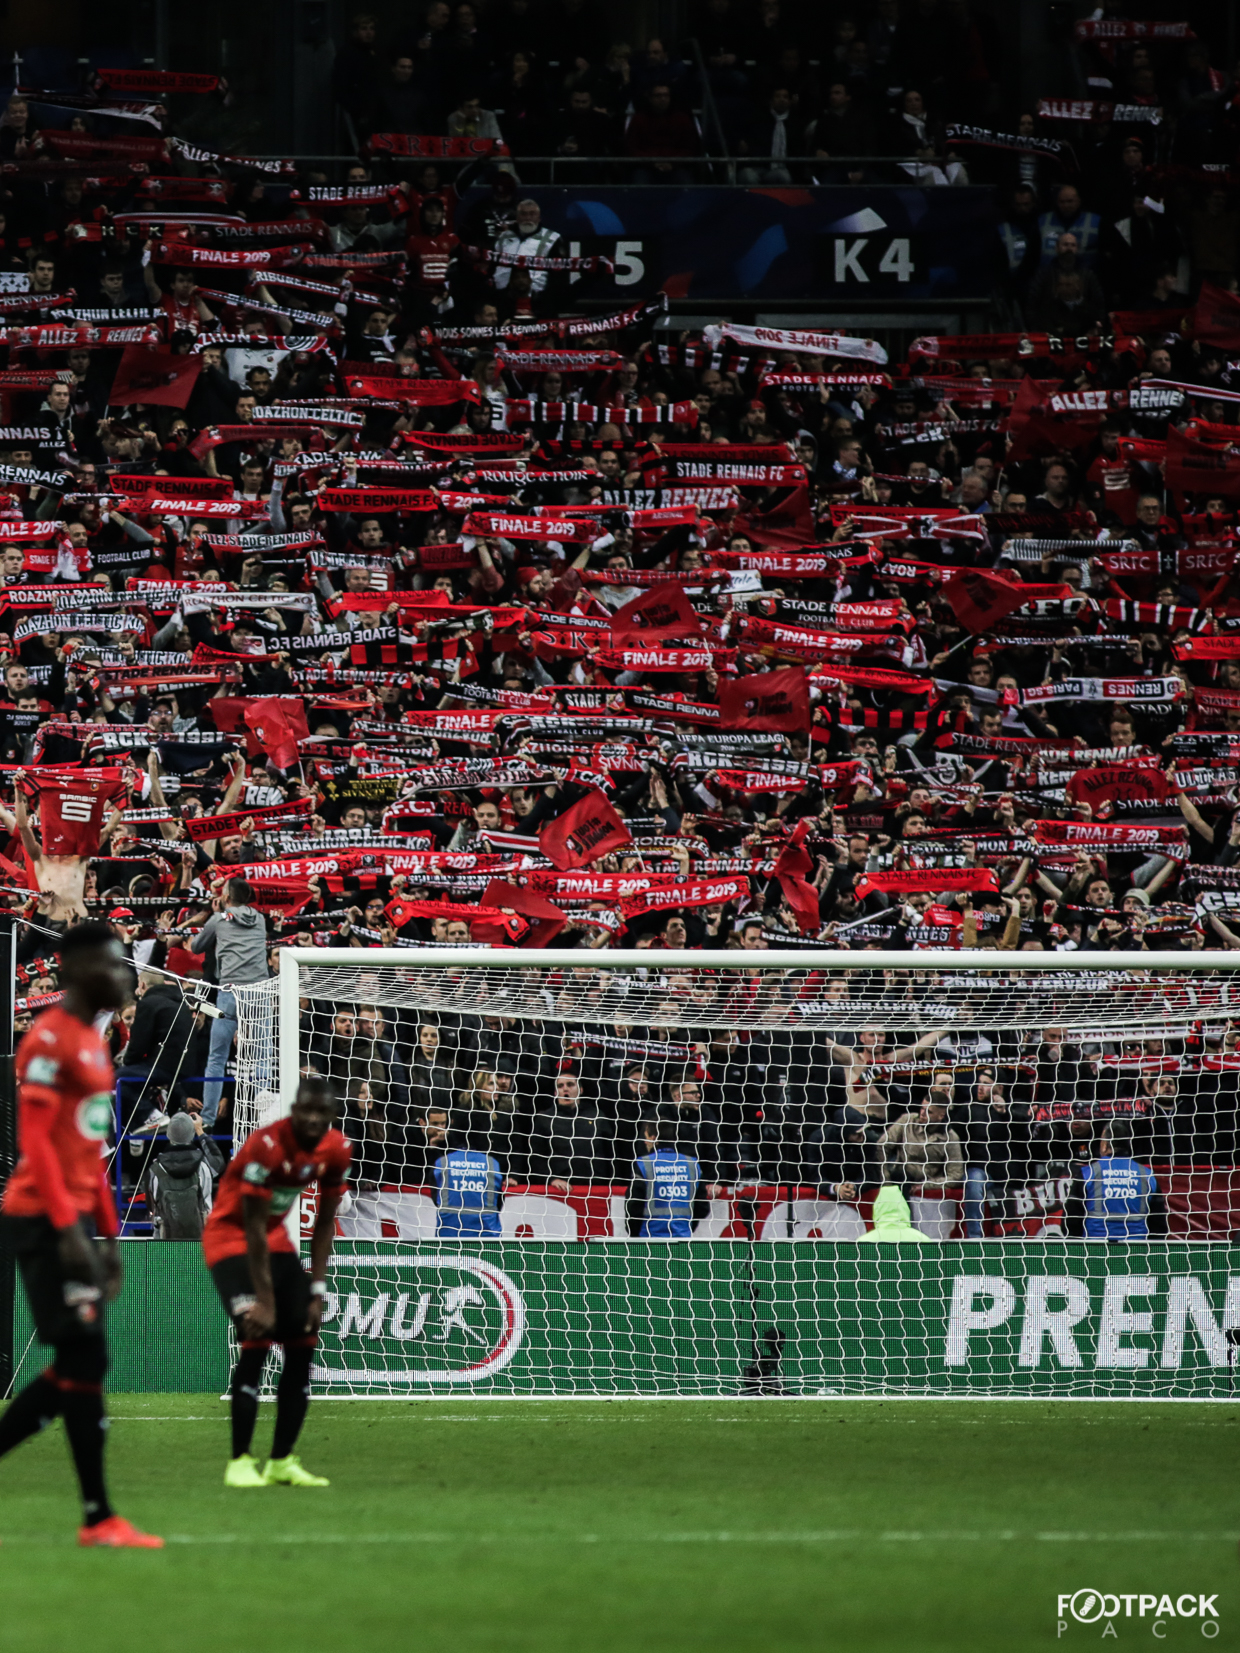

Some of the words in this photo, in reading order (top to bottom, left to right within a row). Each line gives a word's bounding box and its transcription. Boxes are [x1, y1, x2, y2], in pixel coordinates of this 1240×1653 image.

[192, 249, 240, 263] FINALE
[243, 251, 271, 264] 2019
[834, 239, 915, 282] K4
[37, 329, 78, 345] ALLEZ
[435, 326, 457, 340] NOUS
[460, 325, 493, 339] SOMMES
[1053, 392, 1108, 411] ALLEZ
[677, 462, 712, 478] STADE
[716, 462, 767, 480] RENNAIS
[769, 468, 785, 483] FC
[112, 478, 152, 492] STADE
[155, 481, 210, 496] RENNAIS
[603, 490, 656, 510] ALLEZ
[662, 487, 729, 509] RENNES
[151, 500, 207, 514] FINALE
[210, 501, 240, 514] 2019
[32, 521, 63, 535] 2019
[491, 519, 541, 533] FINALE
[546, 519, 575, 535] 2019
[739, 557, 792, 570] FINALE
[796, 559, 826, 571] 2019
[1109, 556, 1150, 570] SRFC
[1185, 552, 1227, 568] SRFC
[782, 601, 826, 612] STADE
[623, 652, 677, 666] FINALE
[680, 652, 712, 666] 2019
[437, 714, 490, 729] FINALE
[1067, 826, 1122, 840] FINALE
[1128, 829, 1159, 842] 2019
[244, 864, 301, 878] FINALE
[306, 860, 338, 874] 2019
[558, 878, 614, 892] FINALE
[618, 879, 650, 891] 2019
[646, 886, 702, 905] FINALE
[706, 882, 737, 897] 2019
[450, 1161, 486, 1169] PROTECT
[452, 1180, 484, 1192] 1206
[659, 1186, 687, 1197] 0303
[1105, 1188, 1137, 1199] 0709
